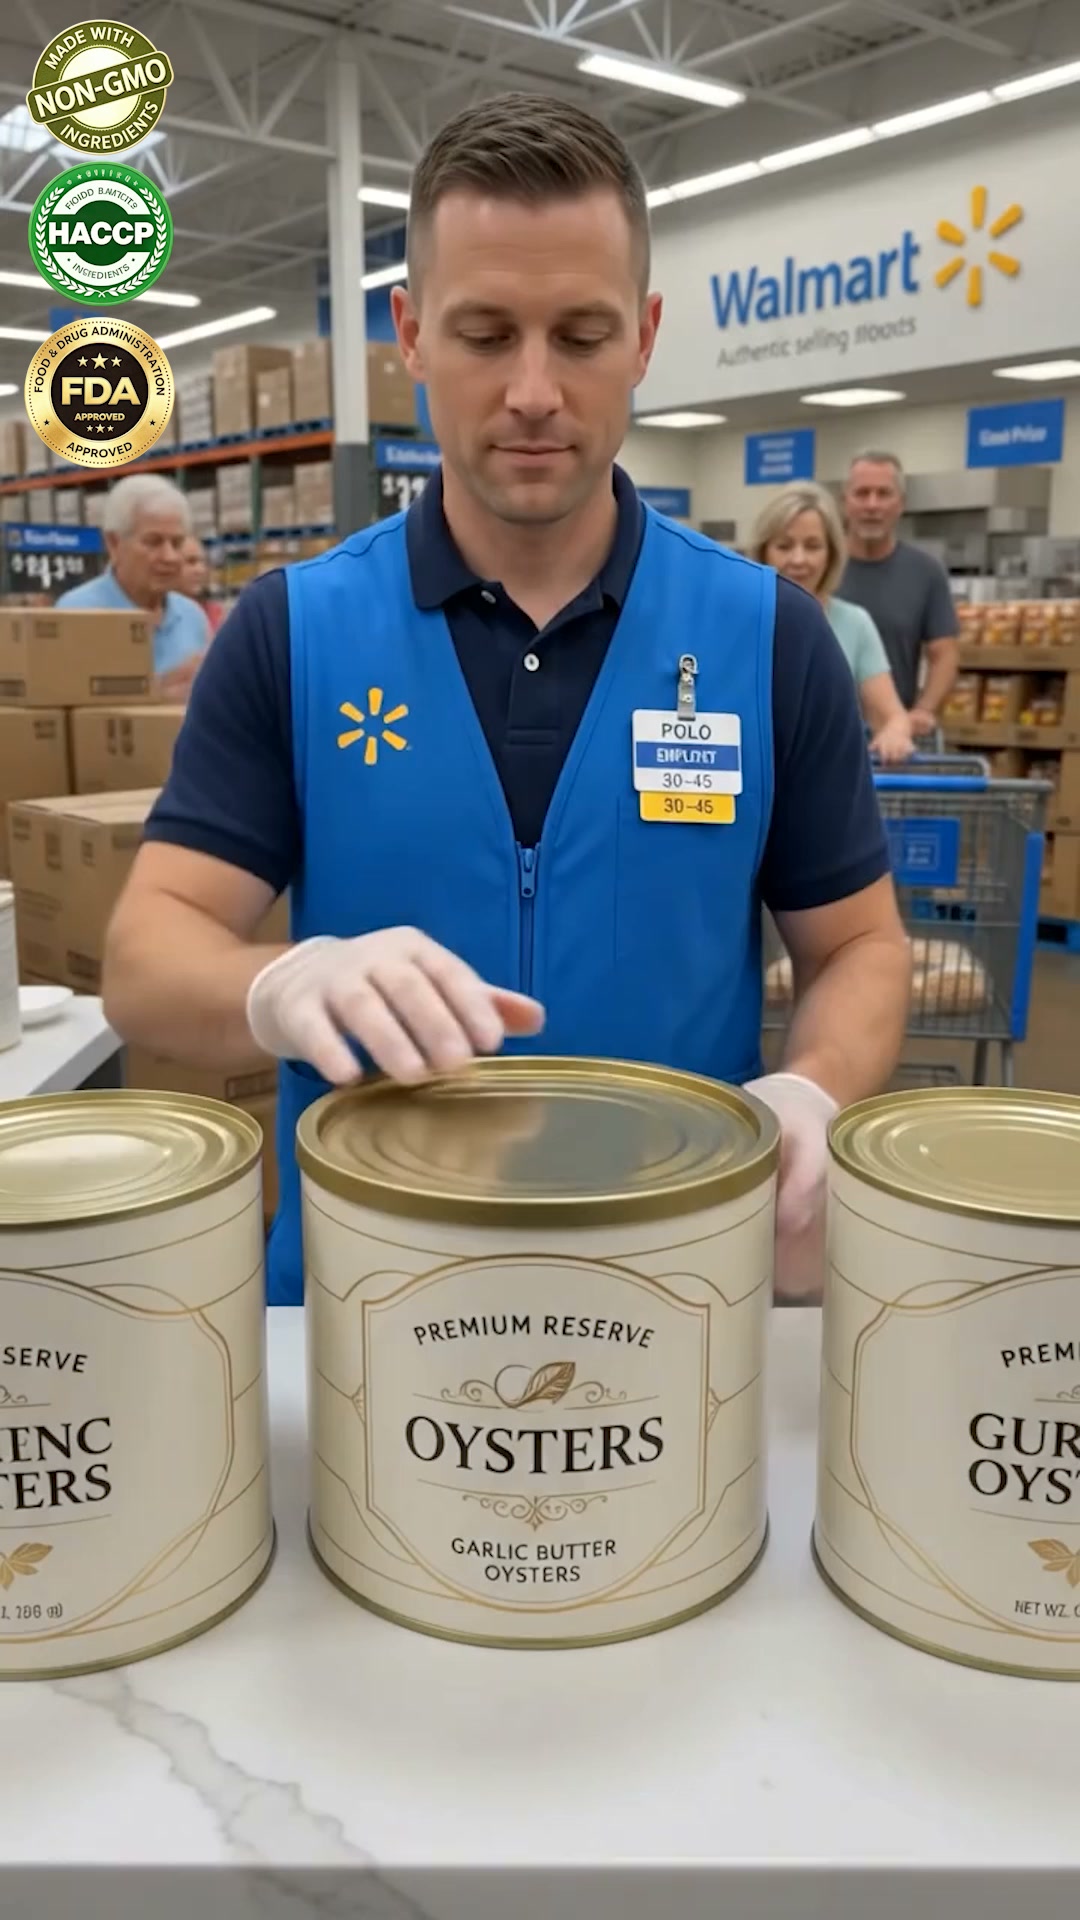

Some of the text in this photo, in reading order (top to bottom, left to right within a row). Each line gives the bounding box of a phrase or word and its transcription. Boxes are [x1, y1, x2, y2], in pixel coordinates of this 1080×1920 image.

[710, 229, 920, 330] Walmart
[661, 723, 712, 740] POLO
[662, 772, 712, 788] 30-45
[664, 797, 714, 814] 30-45
[413, 1314, 656, 1349] PREMIUM RESERVE
[2, 1346, 88, 1373] SERVE
[1001, 1342, 1080, 1368] PREM
[0, 1416, 113, 1463] ENC
[405, 1415, 665, 1474] OYSTERS
[968, 1412, 1080, 1459] GUR
[0, 1463, 112, 1510] ERS
[968, 1458, 1080, 1505] OYS
[451, 1537, 617, 1560] GARLIC BUTTER
[484, 1564, 581, 1583] OYSTERS
[1014, 1600, 1041, 1616] NET
